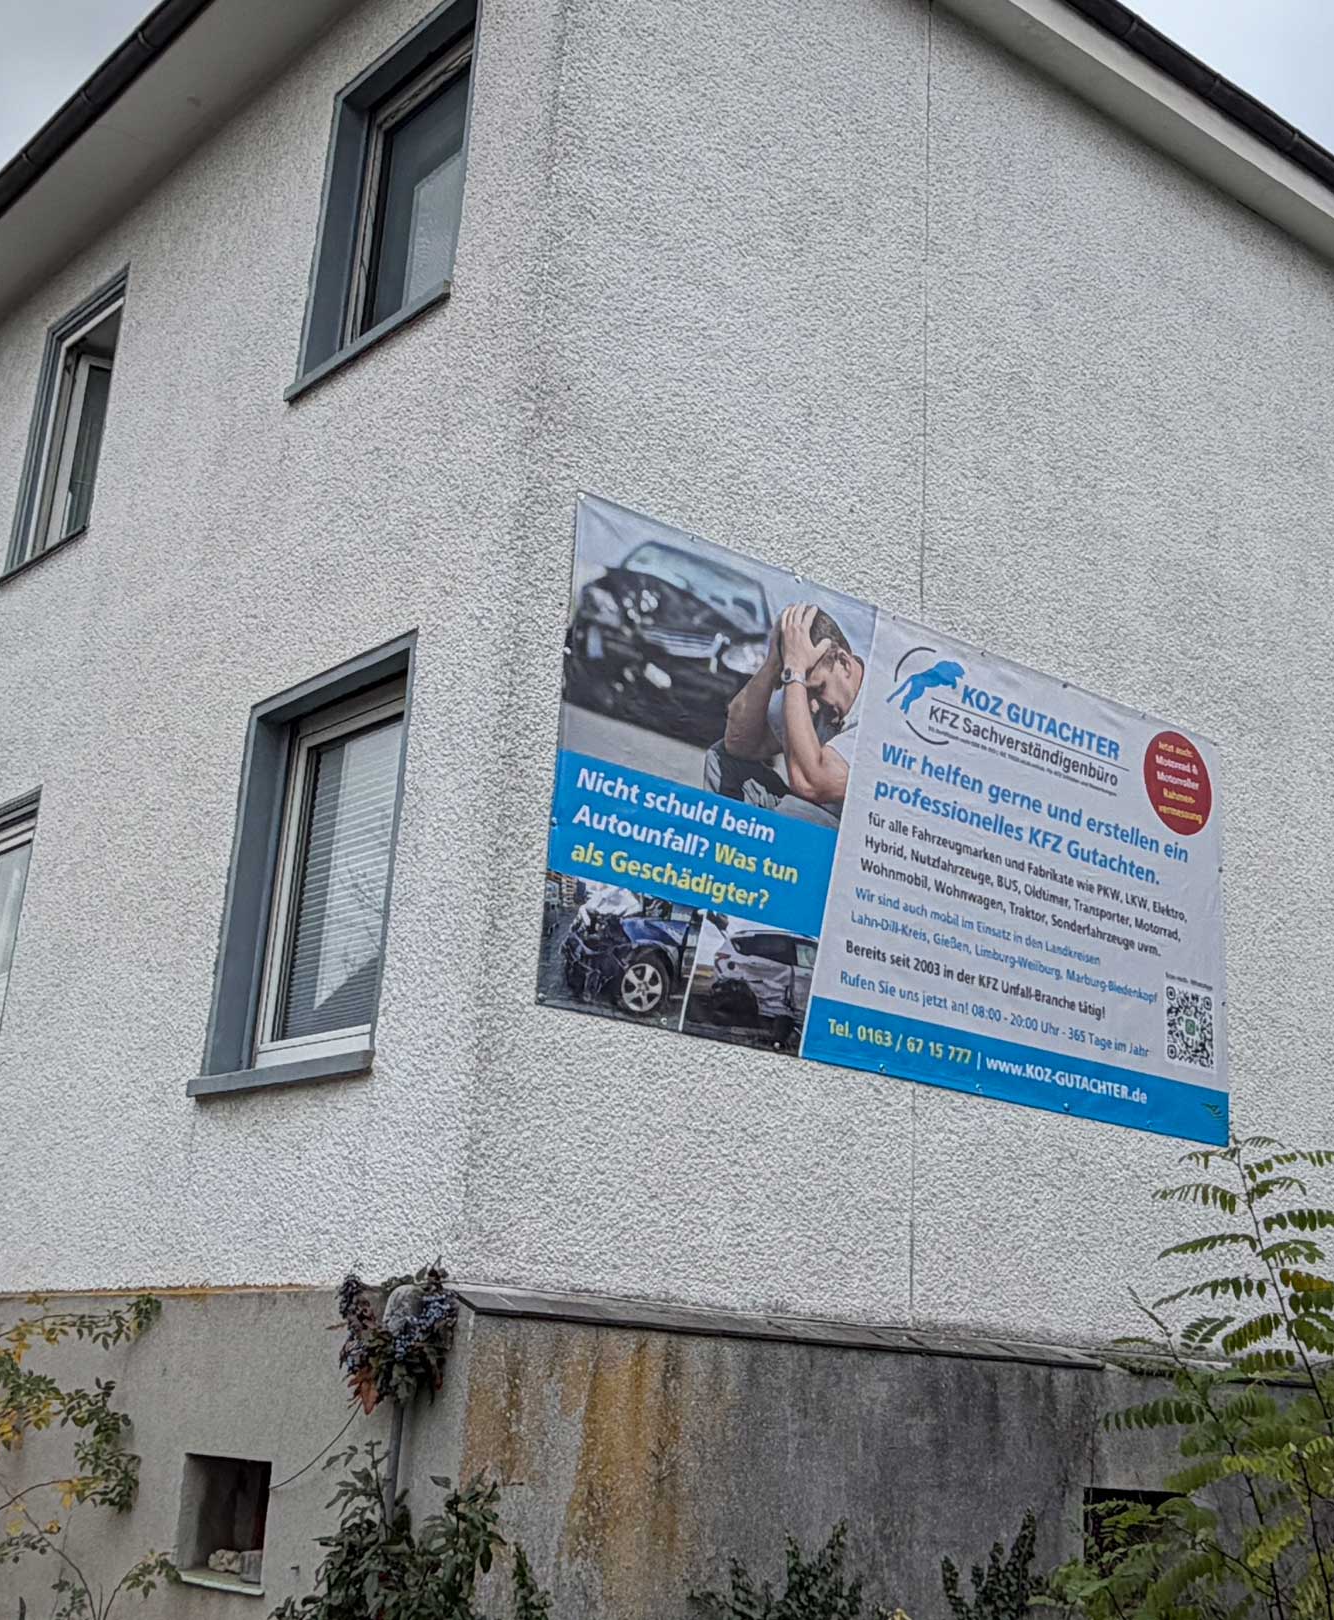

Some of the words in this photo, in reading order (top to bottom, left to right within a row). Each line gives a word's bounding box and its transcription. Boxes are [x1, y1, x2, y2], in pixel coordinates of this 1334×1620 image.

[929, 705, 960, 729] KFZ
[963, 718, 1118, 786] Sachverständigenbüro
[961, 685, 1003, 717] KOZ
[1007, 703, 1121, 760] GUTACHTER
[576, 767, 641, 804] Nicht
[643, 791, 718, 826] schuld
[721, 809, 776, 843] beim
[882, 742, 917, 770] Wir
[921, 756, 983, 793] helfen
[988, 784, 1043, 813] gerne
[1047, 803, 1083, 827] und
[1086, 817, 1159, 853] erstellen
[1163, 842, 1188, 863] ein
[1155, 754, 1190, 774] Motorrad
[1156, 770, 1200, 791] Motorroller
[572, 804, 710, 858] Autounfall?
[715, 842, 757, 873] Was
[762, 857, 799, 884] tun
[868, 811, 885, 829] für
[888, 820, 909, 836] alle
[911, 825, 1002, 865] Fahrzeugmarken
[1005, 856, 1025, 872] und
[1027, 861, 1074, 887] Fabrikate
[1076, 879, 1095, 894] wie
[1097, 884, 1123, 903] PKW,
[1125, 893, 1150, 912] LKW,
[1152, 900, 1188, 924] Elektro,
[874, 780, 1024, 842] professionelles
[1028, 826, 1063, 853] KFZ
[1068, 840, 1160, 885] Gutachten.
[570, 842, 604, 867] als
[610, 850, 770, 910] Geschädigter?
[860, 857, 932, 892] Wohnmobil,
[934, 879, 1007, 914] Wohnwagen,
[1009, 901, 1048, 926] Traktor,
[1051, 913, 1135, 951] Sonderfahrzeuge
[1137, 941, 1161, 957] uvm.
[865, 834, 907, 861] Hybrid,
[910, 848, 994, 887] Nutzfahrzeuge,
[997, 875, 1021, 895] BUS,
[1024, 882, 1071, 910] Oldtimer,
[1073, 898, 1132, 929] Transporter,
[1134, 917, 1181, 943] Motorrad,
[851, 910, 930, 944] Lahn-Dill-Kreis,
[933, 932, 972, 955] Gießen,
[975, 943, 1062, 981] Limburg-Weilburg,
[1066, 968, 1158, 1005] Marburg-Biedenkopf
[855, 886, 875, 903] Wir
[878, 893, 900, 910] sind
[902, 901, 928, 918] auch
[930, 909, 959, 926] mobil
[961, 916, 974, 931] im
[976, 920, 1011, 942] Einsatz
[1013, 931, 1023, 945] in
[1025, 935, 1043, 951] den
[1045, 940, 1101, 966] Landkreisen
[840, 970, 875, 992] Rufen
[878, 980, 897, 997] Sie
[899, 987, 919, 1002] uns
[922, 990, 948, 1009] jetzt
[951, 1000, 969, 1015] an!
[971, 1005, 1002, 1022] 08:00
[1010, 1015, 1038, 1032] 20:00
[1040, 1020, 1060, 1036] Uhr
[1068, 1027, 1086, 1043] 365
[1088, 1033, 1112, 1051] Tage
[1114, 1041, 1127, 1052] im
[1129, 1043, 1149, 1057] Jahr
[845, 939, 887, 963] Bereits
[890, 953, 911, 969] seit
[913, 958, 941, 976] 2003
[943, 965, 954, 980] in
[957, 969, 976, 985] der
[978, 974, 999, 991] KFZ
[1001, 981, 1076, 1012] Unfall-Branche
[1078, 1001, 1106, 1021] tätig!
[828, 1017, 853, 1039] Tel.
[857, 1025, 892, 1046] 0163
[895, 1033, 903, 1053] /
[906, 1037, 924, 1054] 67
[929, 1041, 944, 1058] 15
[948, 1045, 972, 1064] 777
[986, 1056, 1148, 1104] www.KOZ-GUTACHTER.de
